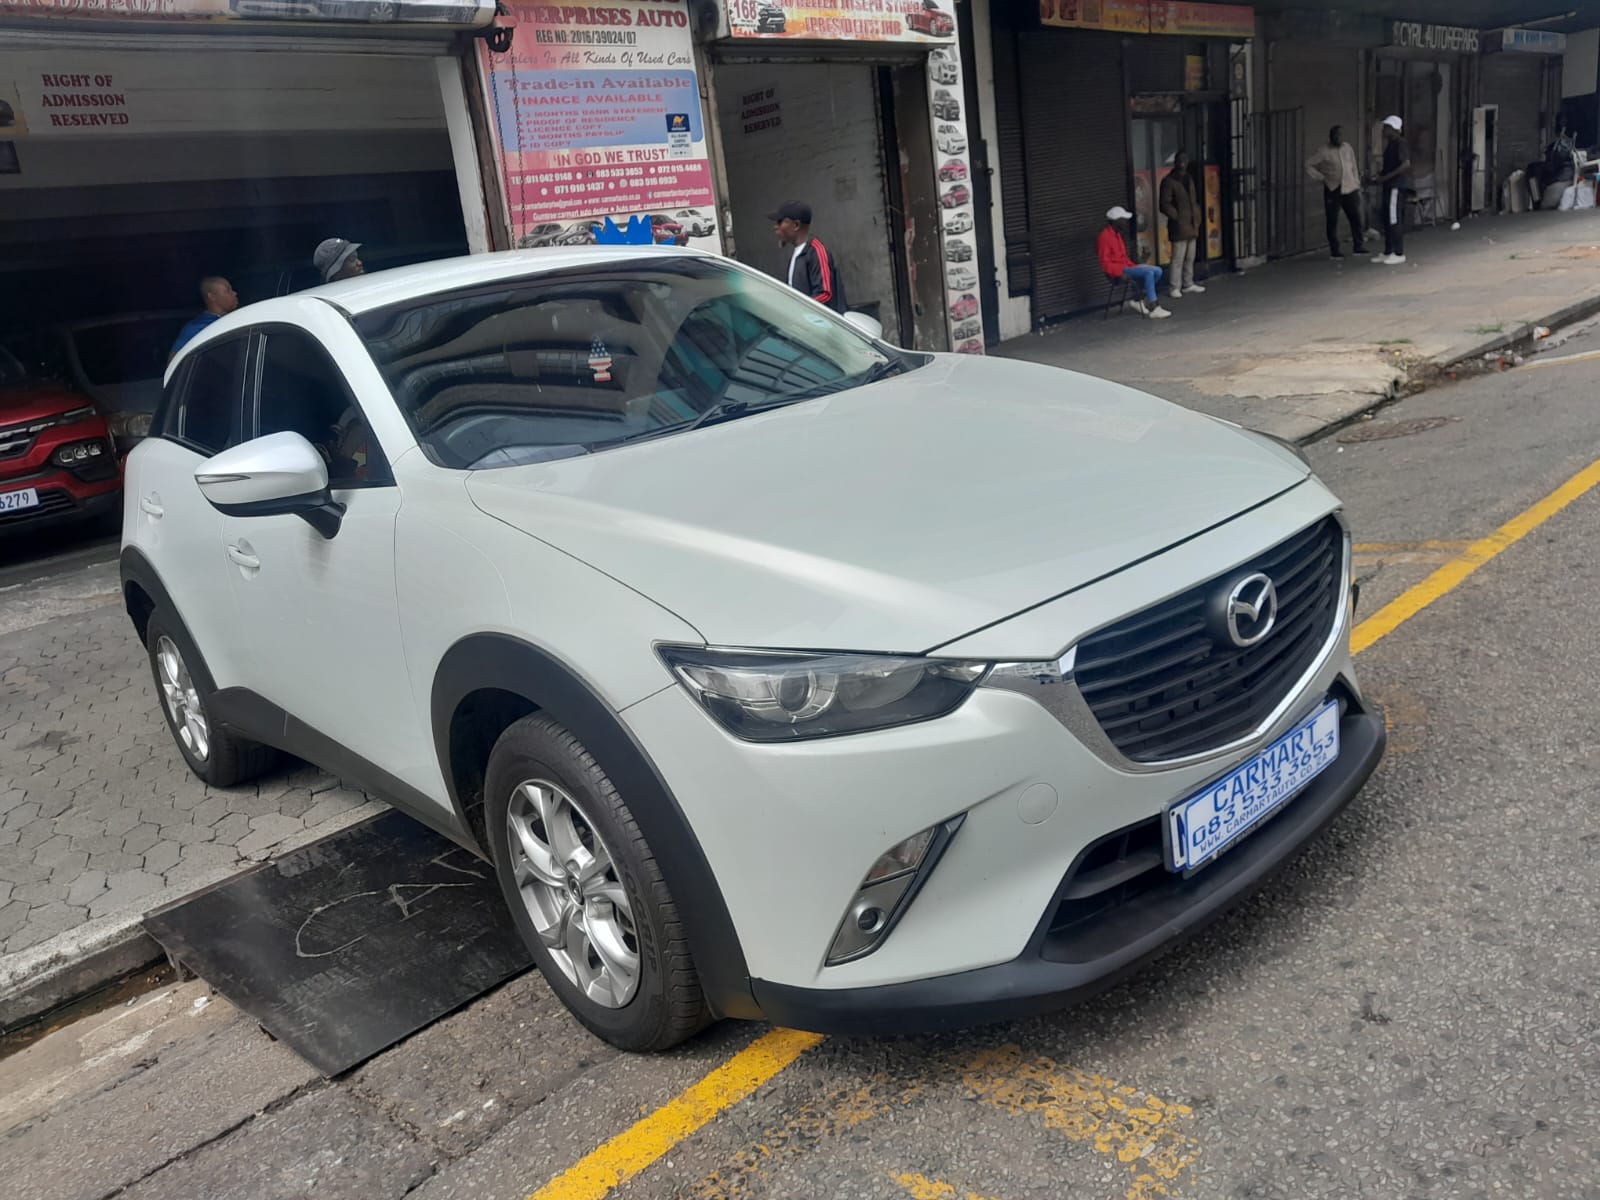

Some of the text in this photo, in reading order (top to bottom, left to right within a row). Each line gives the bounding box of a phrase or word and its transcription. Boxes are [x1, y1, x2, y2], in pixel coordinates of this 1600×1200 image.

[734, 0, 757, 20] 168
[636, 9, 688, 28] AUTO
[536, 30, 554, 43] REG
[561, 50, 580, 63] All
[583, 51, 616, 64] Kinds
[621, 51, 634, 67] Of
[637, 51, 663, 64] Used
[667, 52, 691, 65] Cars
[41, 74, 113, 88] RIGHT OF
[504, 77, 691, 91] Trade-in Available
[41, 93, 126, 107] ADMISSION
[585, 93, 663, 104] AVAILABLE
[50, 112, 129, 127] RESERVED
[574, 152, 600, 165] GOD
[604, 151, 623, 163] WE
[1213, 720, 1318, 812] CARMART
[1192, 801, 1235, 847] 083
[1242, 770, 1281, 810] 533
[1288, 730, 1334, 776] 3653
